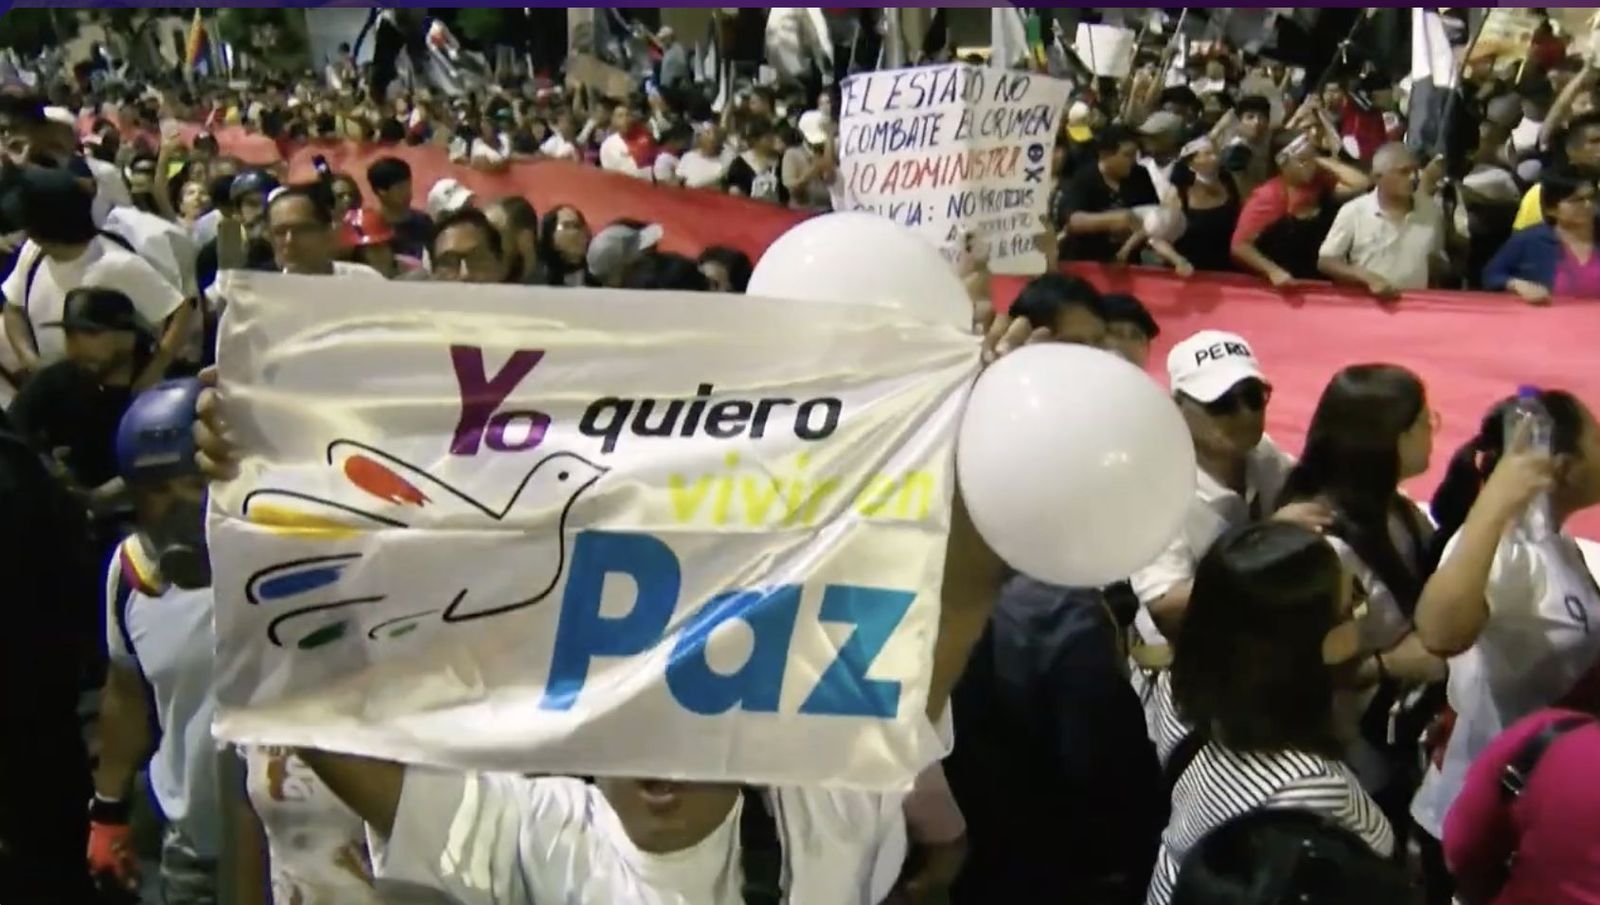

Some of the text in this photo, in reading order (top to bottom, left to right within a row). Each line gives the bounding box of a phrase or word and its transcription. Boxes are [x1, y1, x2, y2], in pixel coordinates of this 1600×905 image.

[842, 67, 1032, 117] EL ESTADO NO
[844, 112, 944, 157] COMBATE
[981, 104, 1056, 140] CRIMEN
[849, 145, 1023, 196] LO ADMINISTRA
[946, 191, 977, 219] NO
[449, 345, 843, 455] Yo quiero
[668, 450, 934, 526] vivir en
[536, 529, 916, 719] Paz
